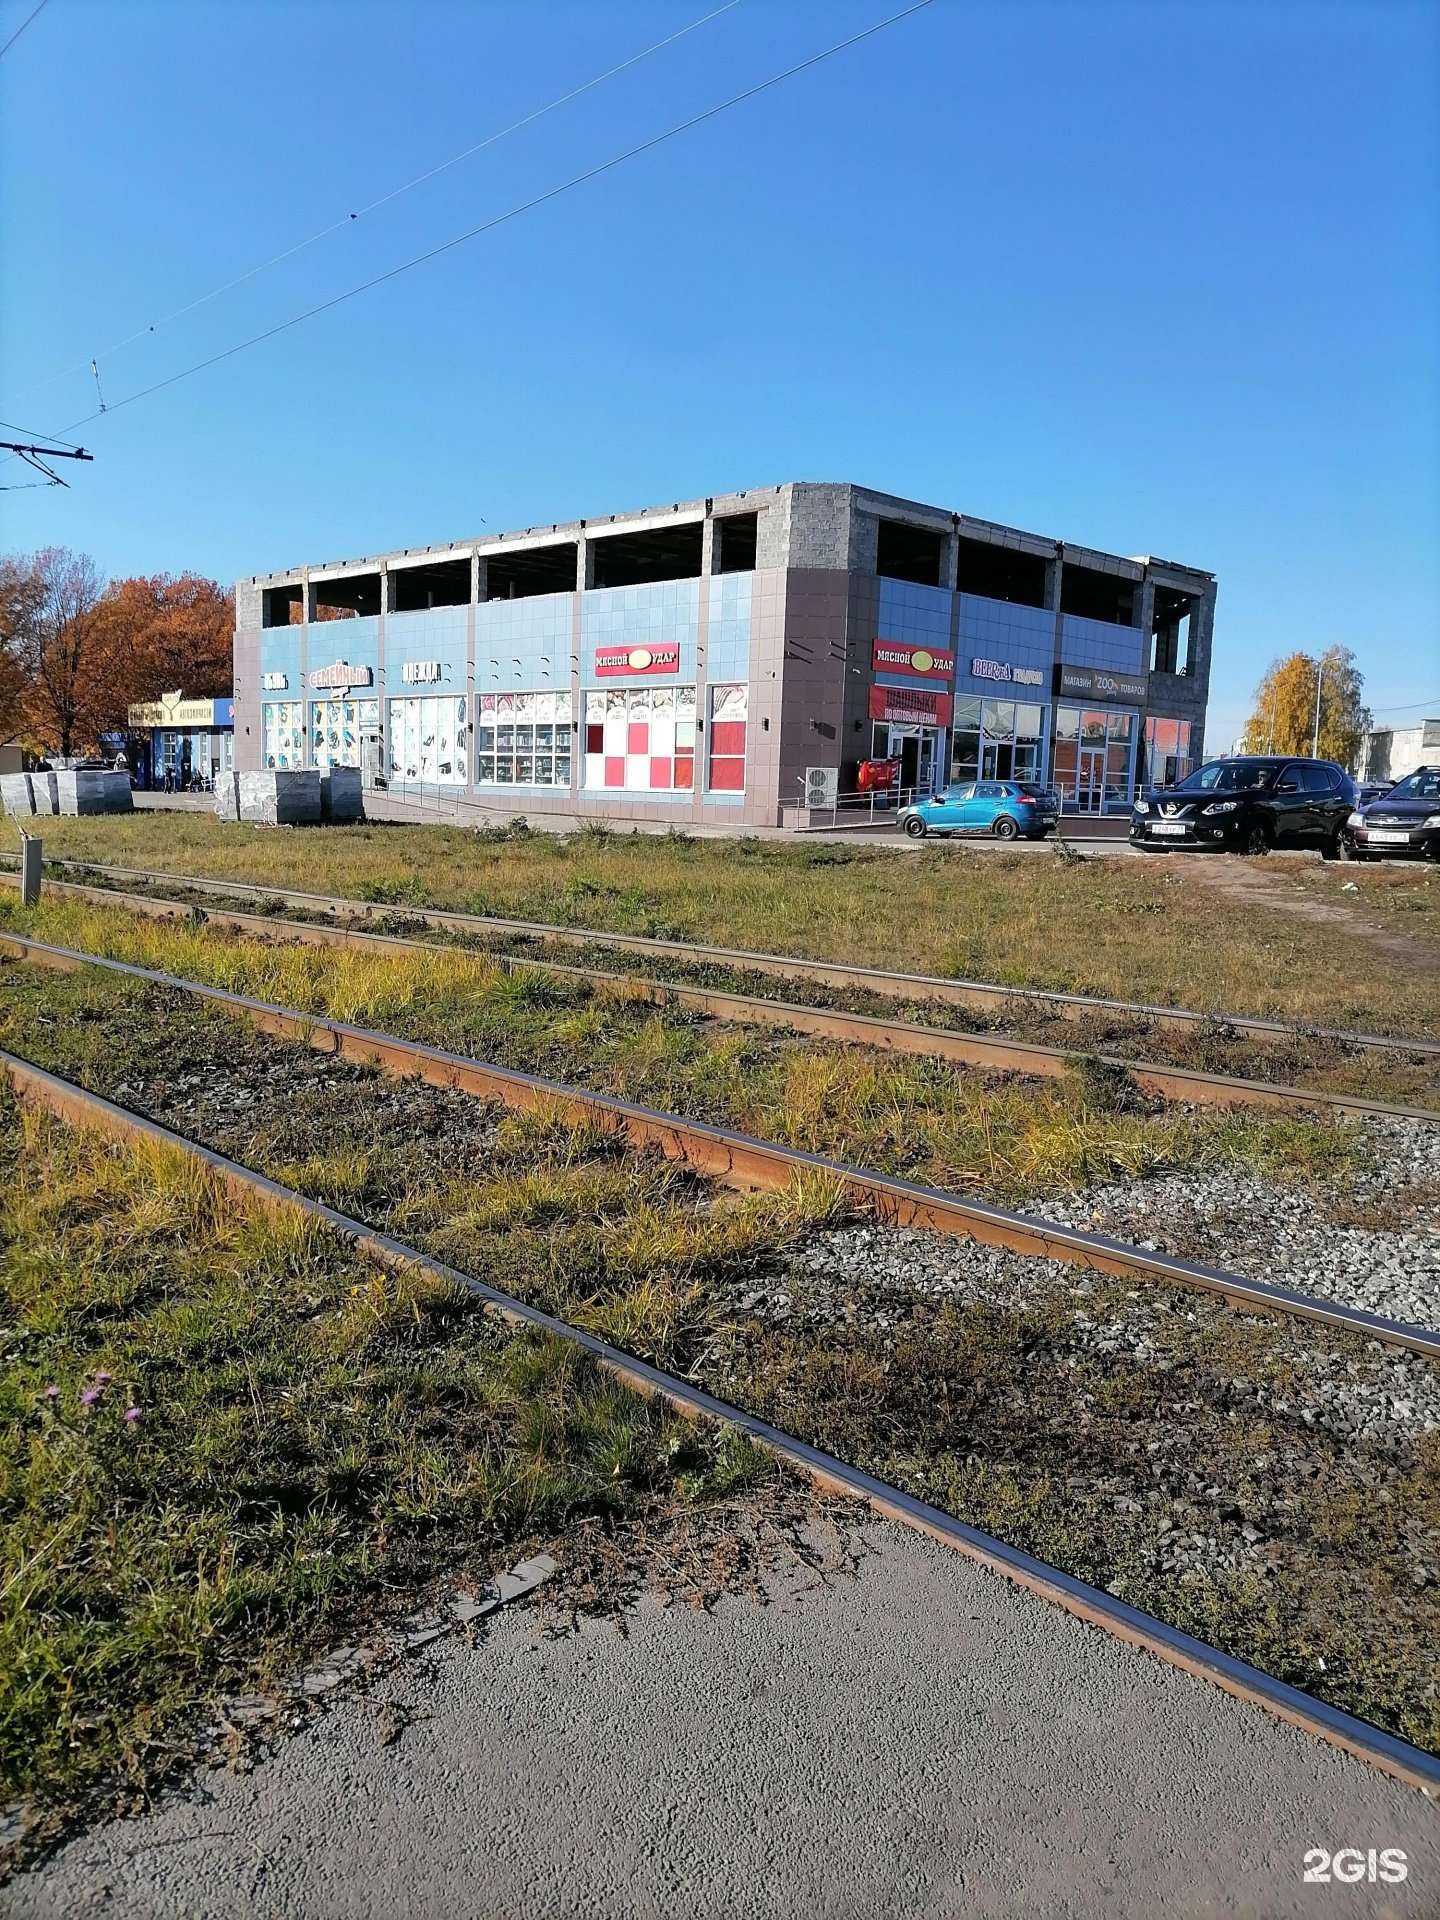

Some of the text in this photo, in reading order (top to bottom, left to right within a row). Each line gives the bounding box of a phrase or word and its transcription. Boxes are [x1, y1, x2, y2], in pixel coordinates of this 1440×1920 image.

[596, 652, 675, 667] МЯСНОЙ УДАР
[877, 650, 954, 672] МЯСНОЙ УДАР
[310, 660, 370, 687] СЕМЕЙНЫЙ
[1064, 676, 1092, 688] МАГАЗИН
[1097, 677, 1113, 690] ZOO
[1120, 683, 1145, 696] ТОВАРОВ
[886, 690, 937, 713] ШАШЛЫКИ
